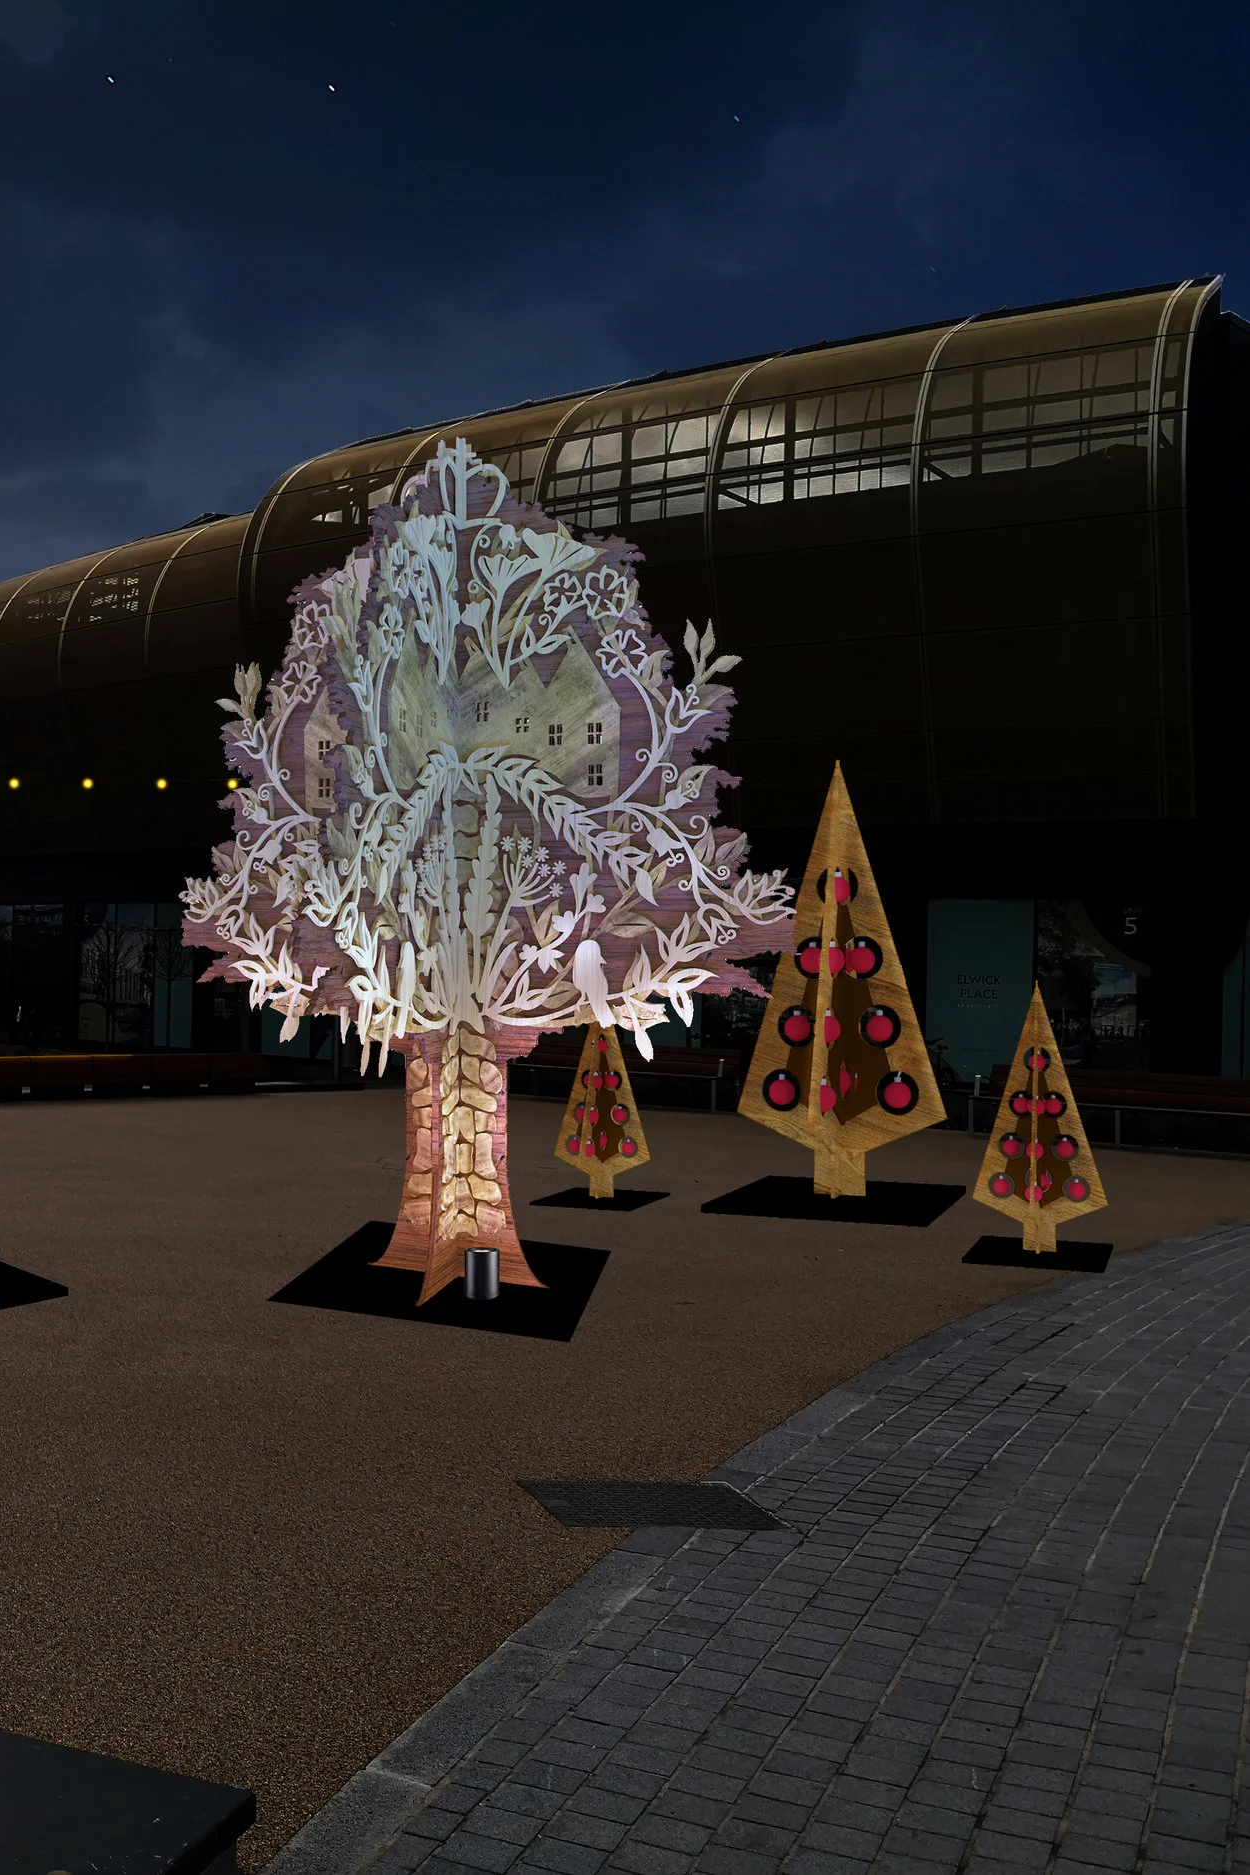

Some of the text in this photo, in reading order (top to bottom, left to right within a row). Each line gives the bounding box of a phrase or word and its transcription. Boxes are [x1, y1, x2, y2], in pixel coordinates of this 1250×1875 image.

[1124, 917, 1137, 935] 5
[957, 974, 1001, 985] ELWICK
[960, 988, 998, 999] PLACE
